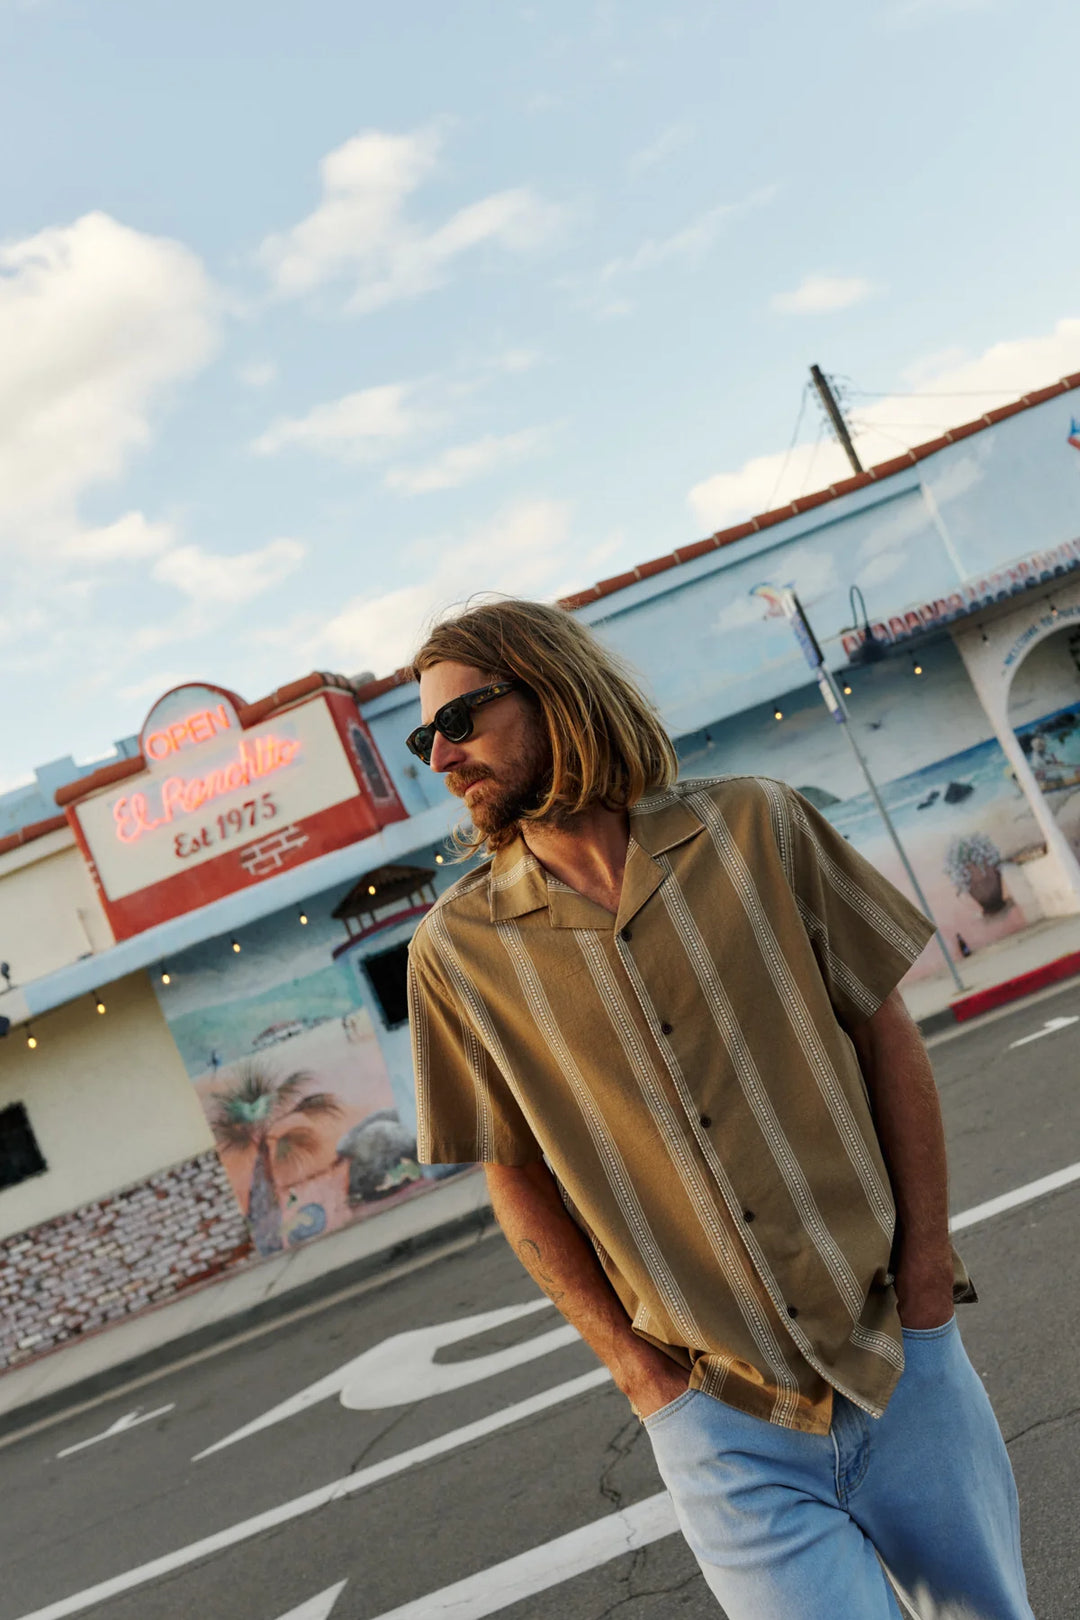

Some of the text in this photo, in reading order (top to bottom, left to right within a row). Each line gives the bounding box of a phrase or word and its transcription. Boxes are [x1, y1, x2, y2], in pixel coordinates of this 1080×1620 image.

[146, 704, 230, 760] OPEN
[113, 793, 163, 843] El
[174, 793, 279, 858] Est 1975
